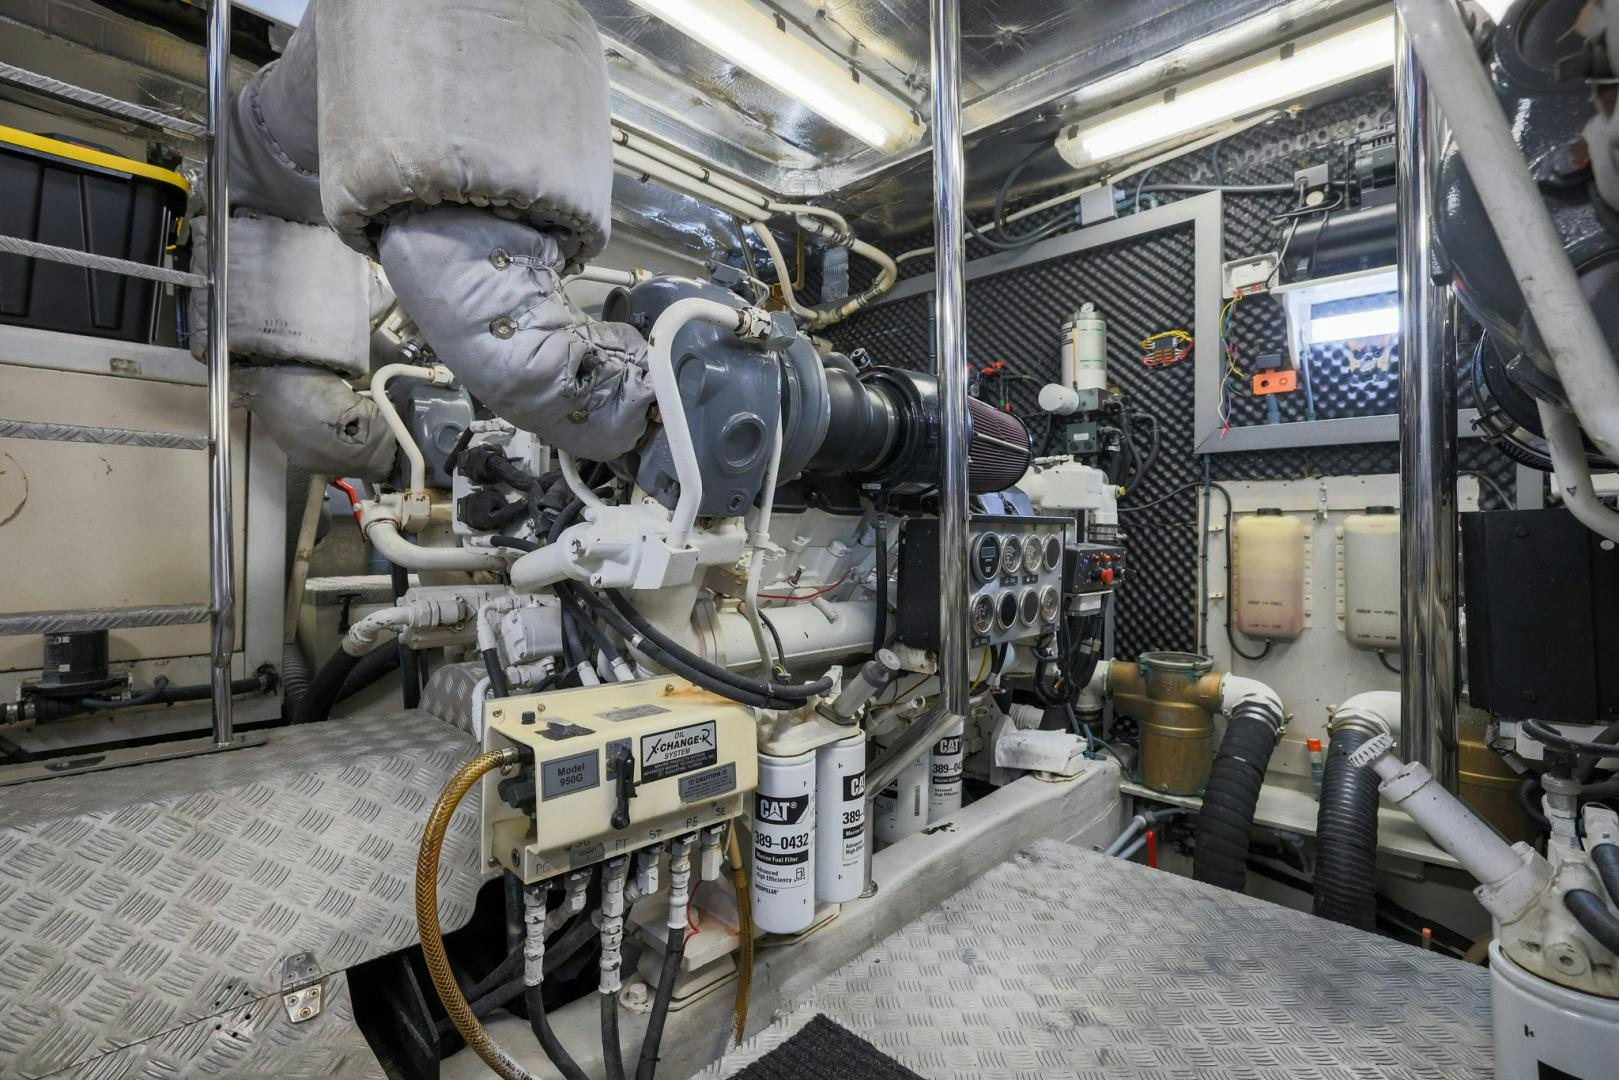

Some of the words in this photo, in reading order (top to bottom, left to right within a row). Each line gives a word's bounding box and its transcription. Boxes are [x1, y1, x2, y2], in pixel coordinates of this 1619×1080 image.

[674, 732, 684, 740] OIL
[940, 739, 959, 753] CAT
[664, 748, 691, 760] SYSTEM
[558, 763, 584, 777] Model
[560, 774, 583, 786] 950G
[695, 771, 721, 784] CAUTION
[760, 800, 790, 822] CAT
[648, 829, 663, 840] ST
[754, 830, 809, 849] 389-0432
[615, 838, 629, 851] PT
[756, 852, 771, 861] Marine
[756, 865, 778, 876] Advanced
[757, 872, 765, 880] High
[766, 874, 792, 883] Efficiency
